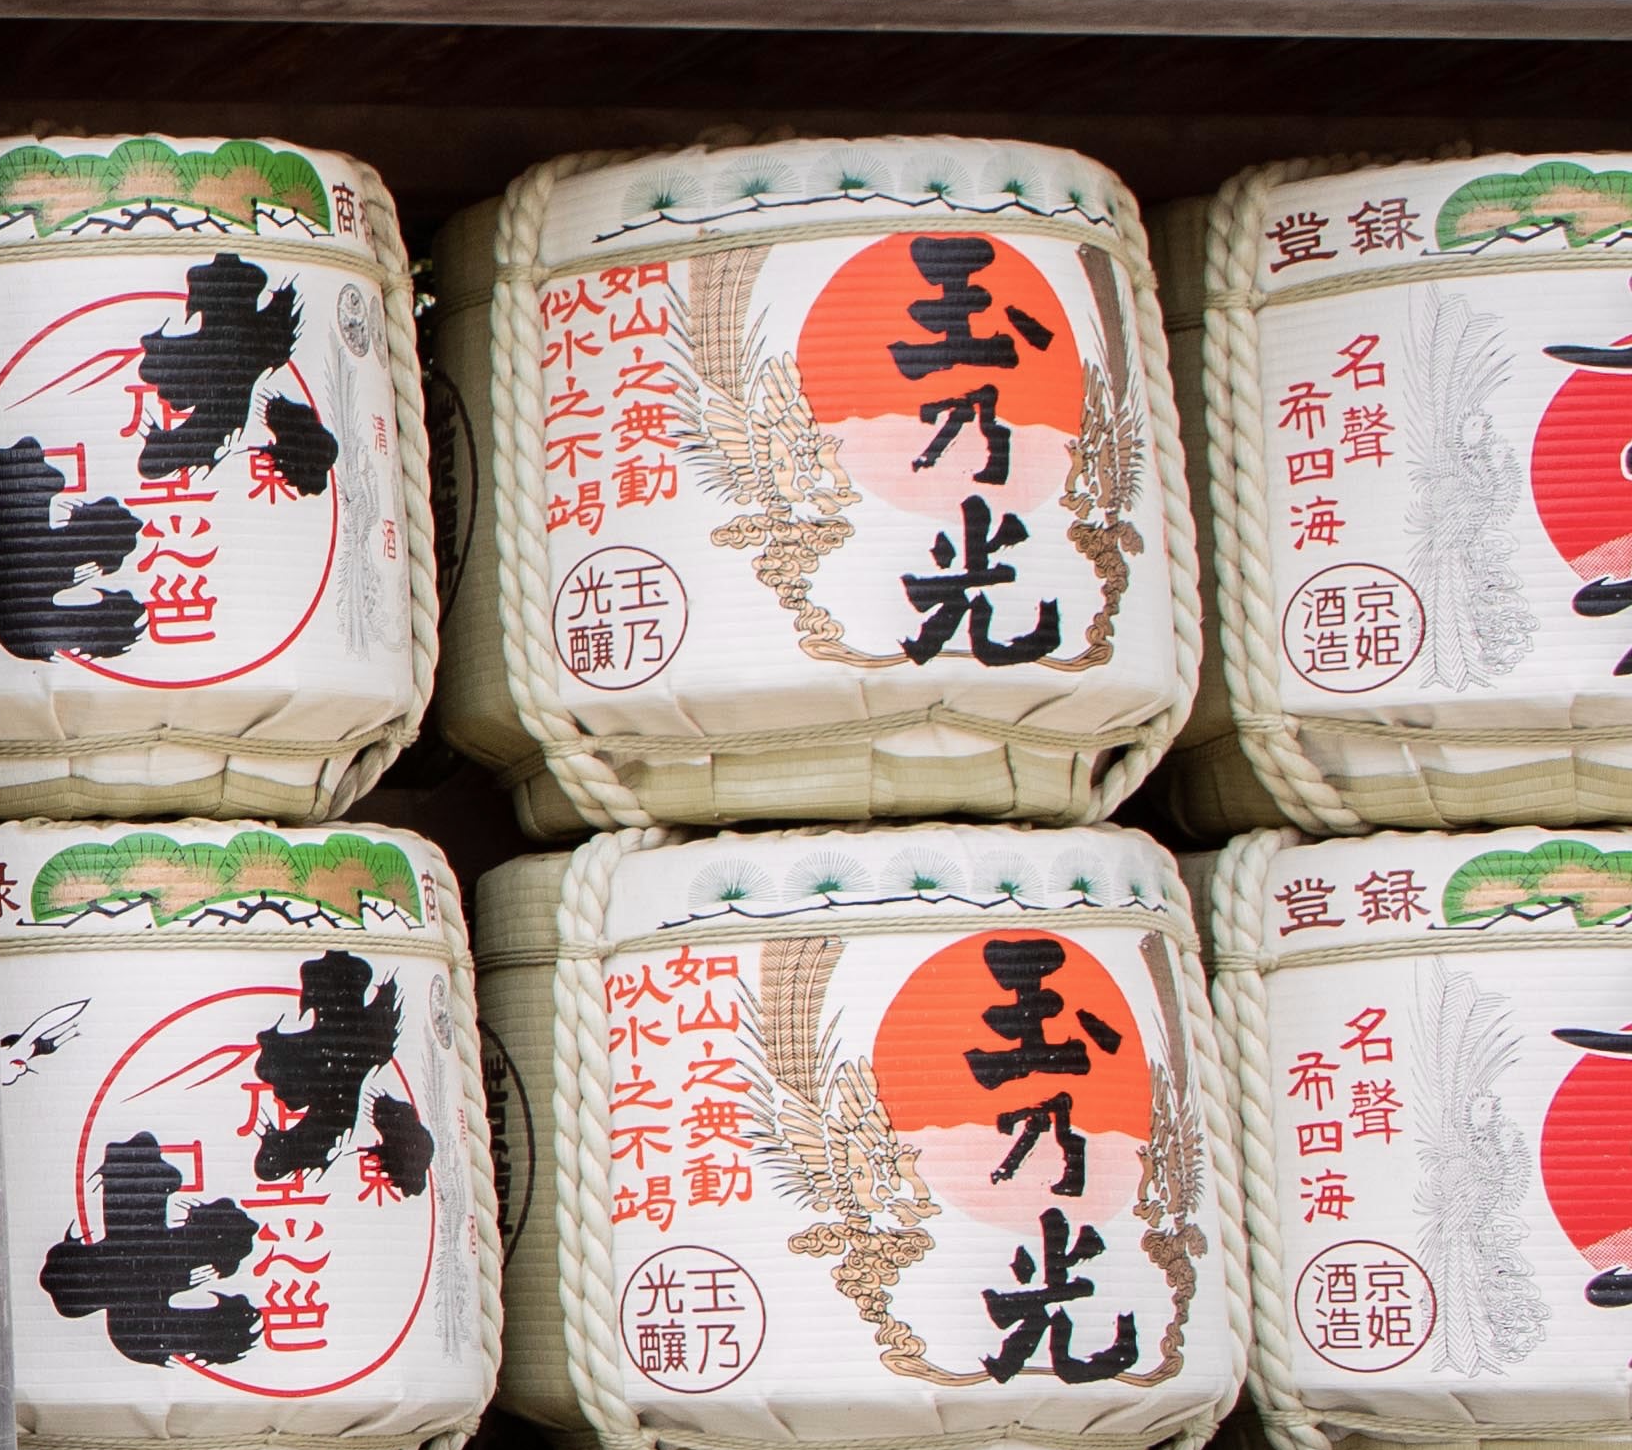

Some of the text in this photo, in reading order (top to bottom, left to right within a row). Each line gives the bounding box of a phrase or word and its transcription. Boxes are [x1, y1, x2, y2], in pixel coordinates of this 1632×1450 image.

[1266, 198, 1424, 273] 登録
[888, 236, 1060, 667] 玉乃光
[1274, 869, 1431, 935] 登録
[964, 939, 1139, 1384] 玉乃光
